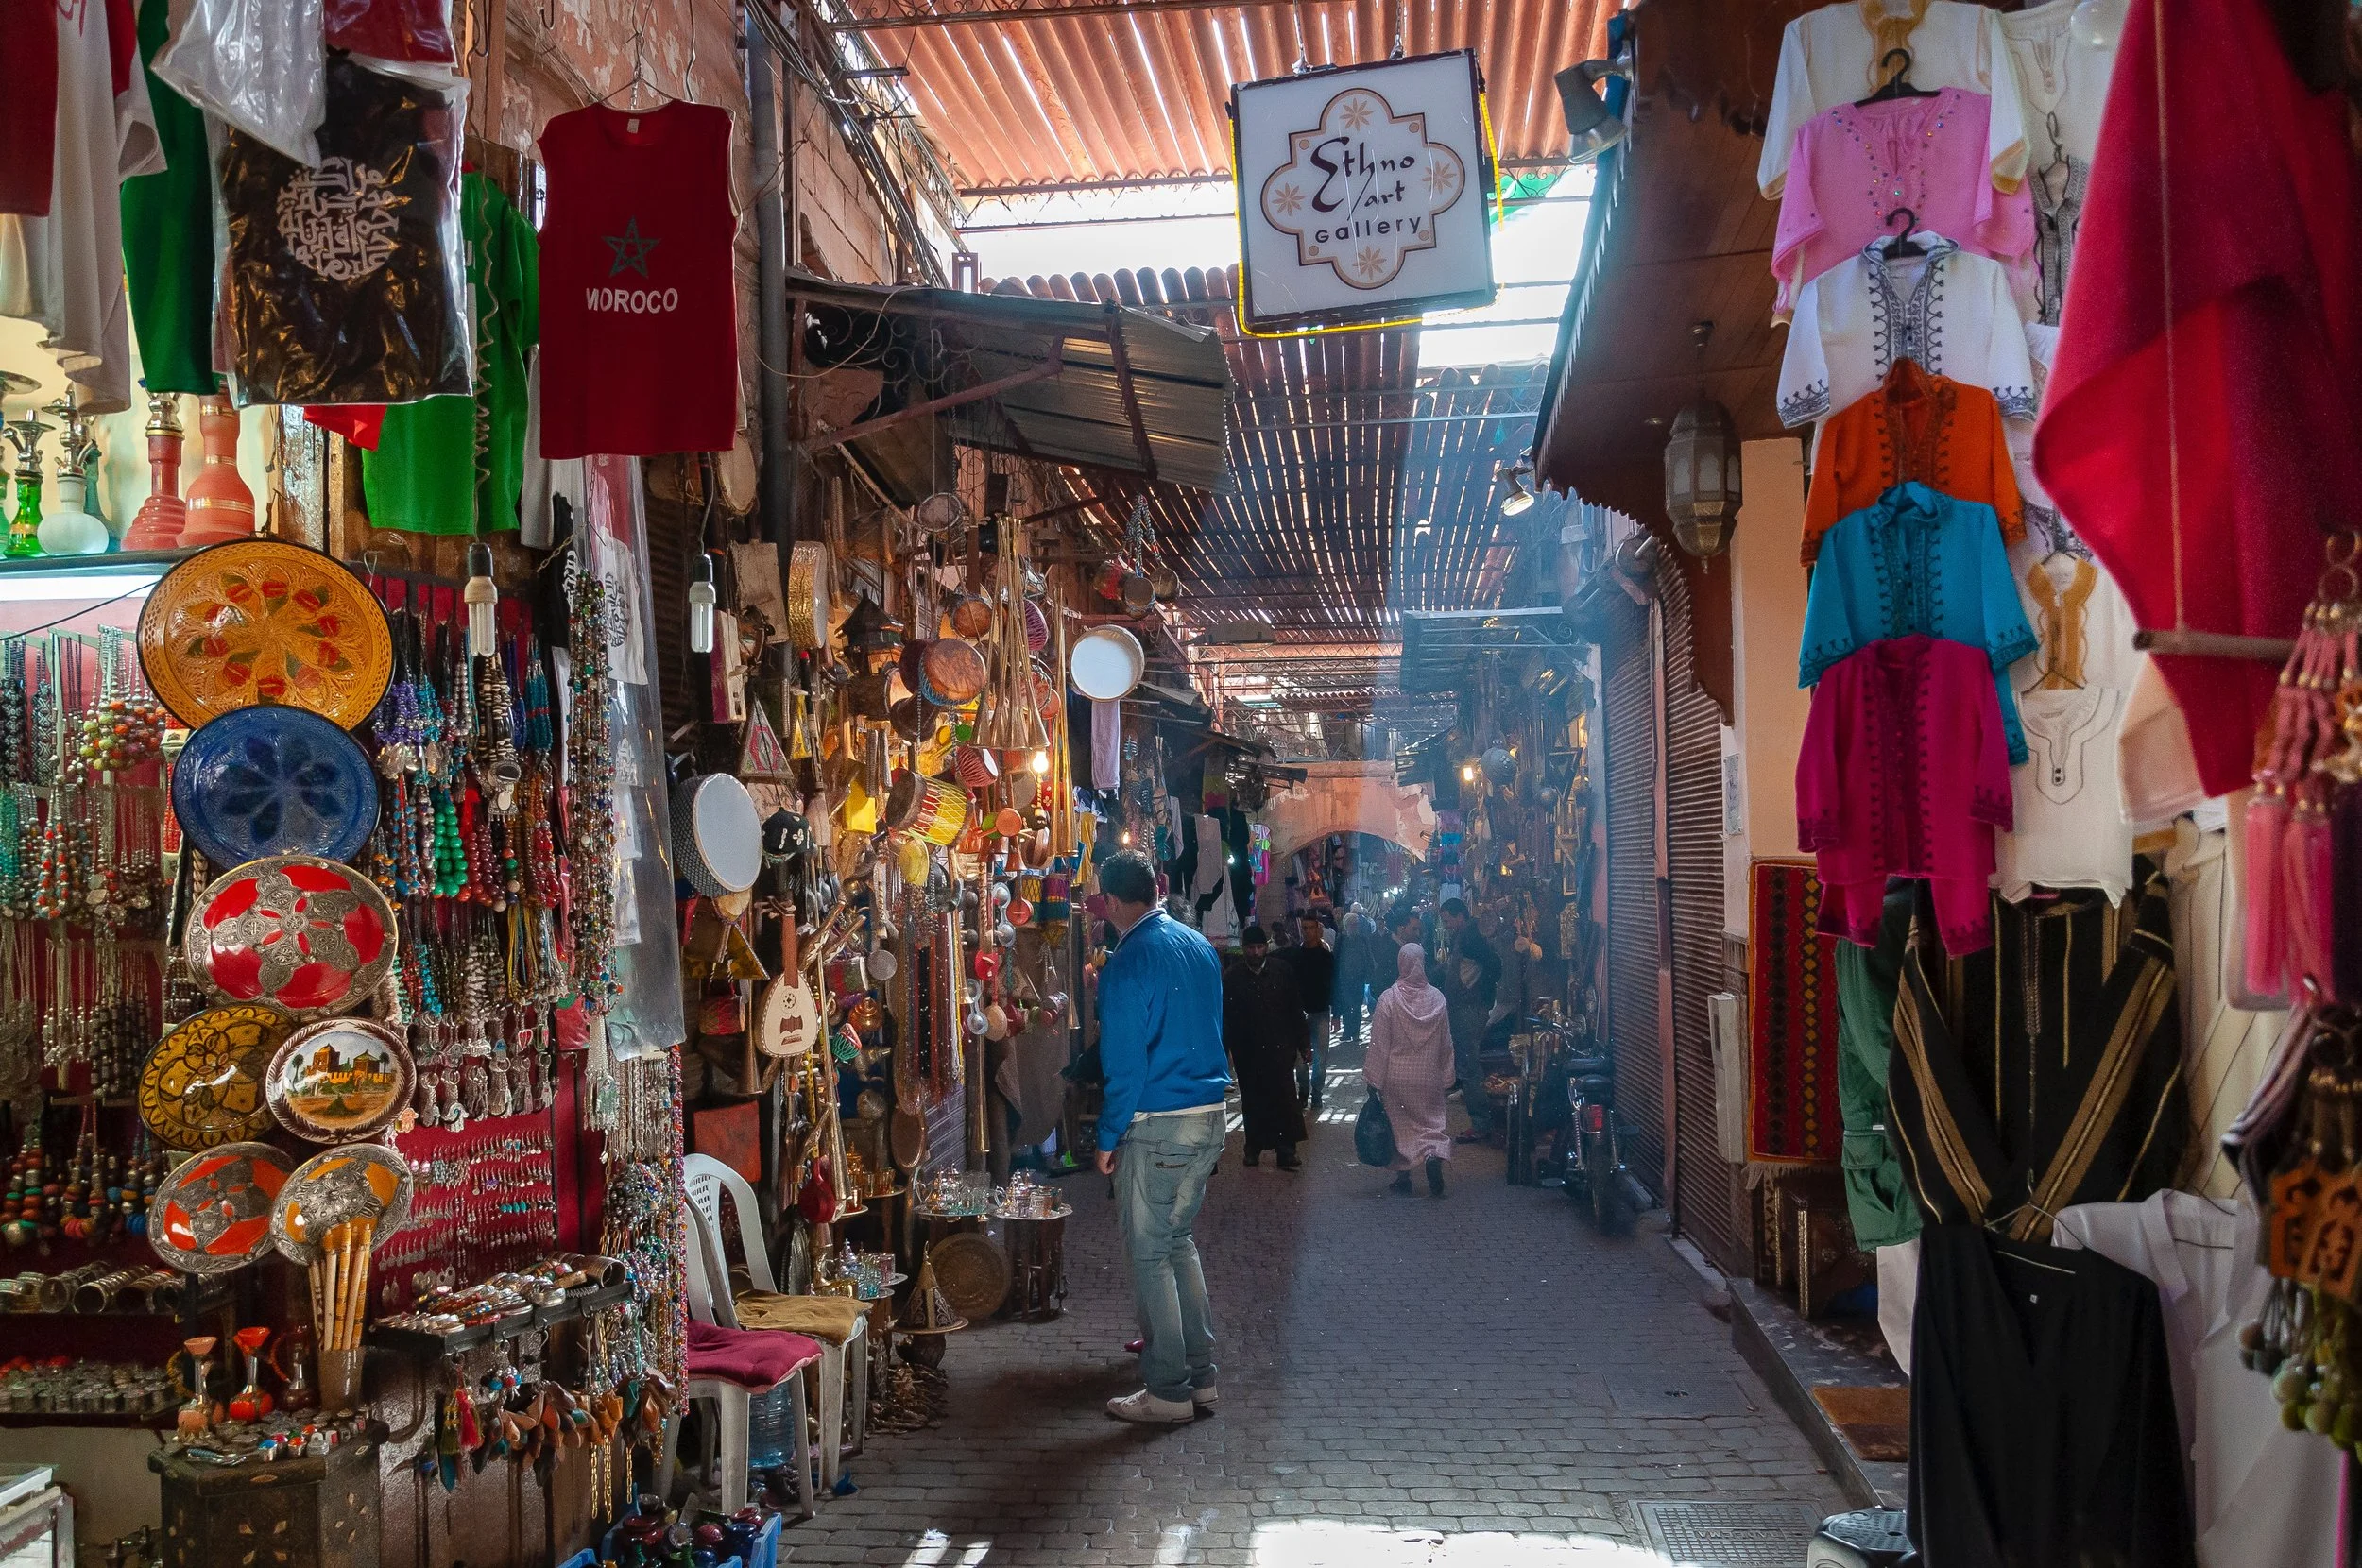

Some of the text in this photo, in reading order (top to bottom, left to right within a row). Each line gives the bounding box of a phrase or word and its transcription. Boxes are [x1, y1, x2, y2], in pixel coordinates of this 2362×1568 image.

[1310, 136, 1415, 221] Ethno
[1364, 179, 1405, 208] art
[1315, 215, 1421, 244] Gallery
